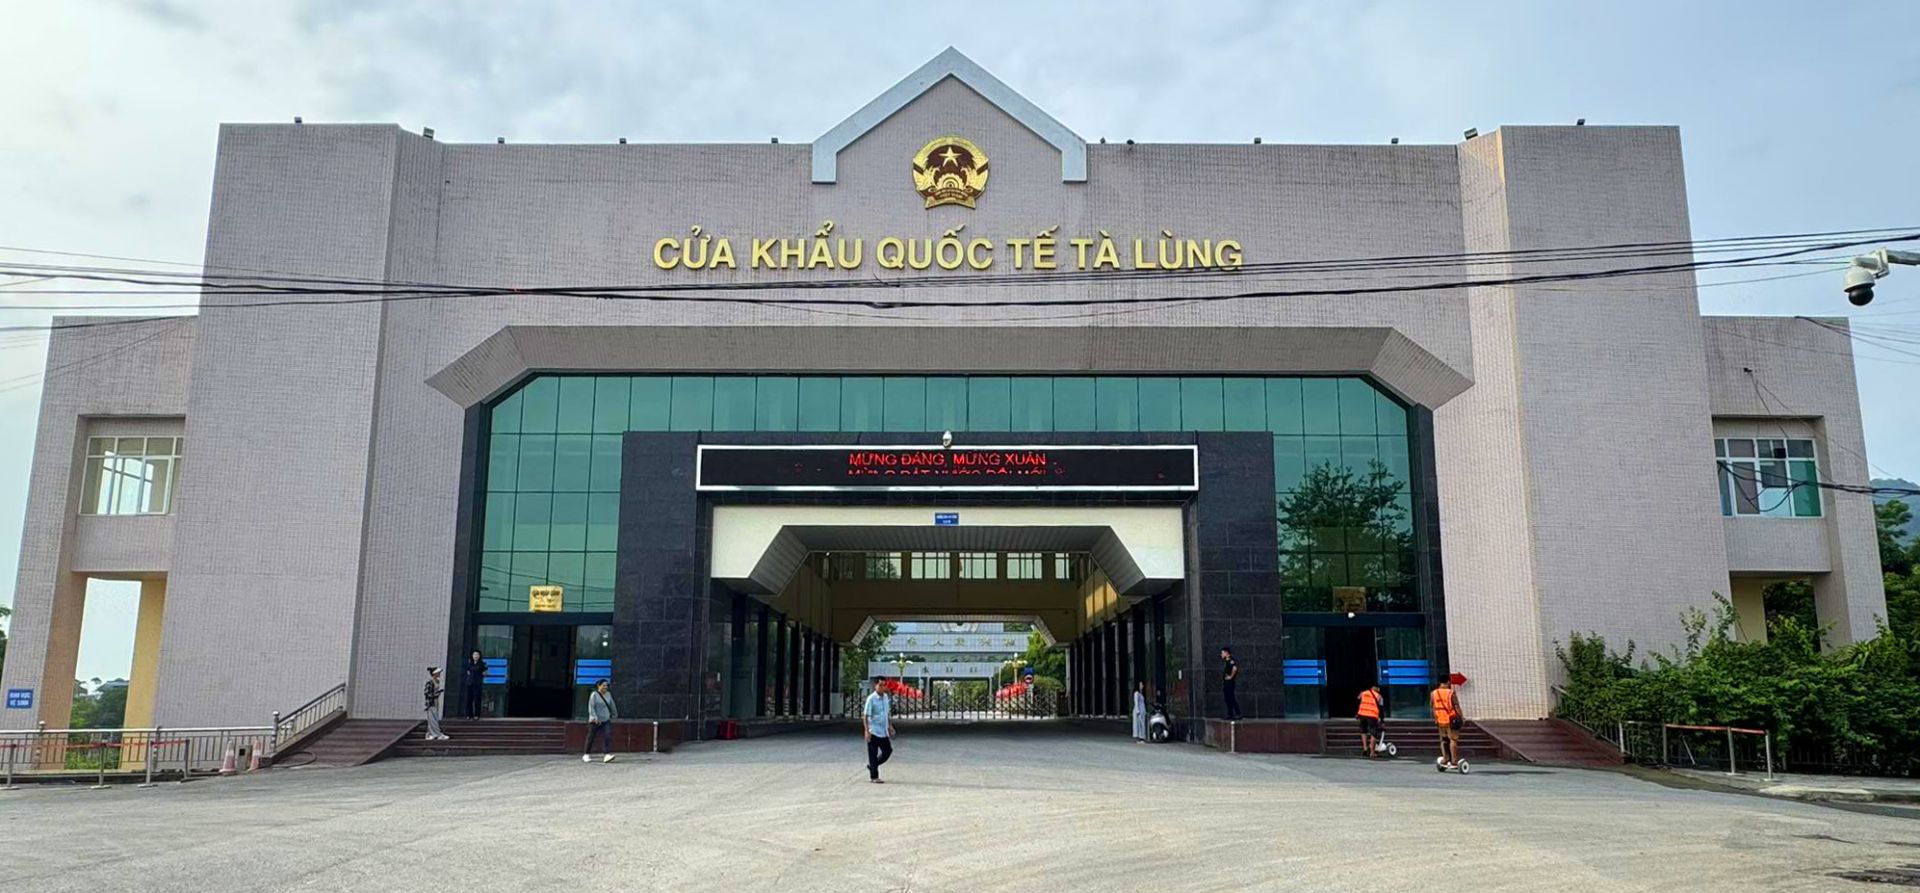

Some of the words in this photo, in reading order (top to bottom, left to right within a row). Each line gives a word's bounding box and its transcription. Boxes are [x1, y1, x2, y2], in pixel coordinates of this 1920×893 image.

[653, 224, 736, 269] CỬA
[751, 220, 863, 269] KHẨU
[876, 224, 994, 270] QUỐC
[1006, 224, 1060, 270] TẾ
[1070, 229, 1121, 270] TÀ
[1135, 229, 1243, 271] LÙNG
[1004, 451, 1047, 466] XUÂN
